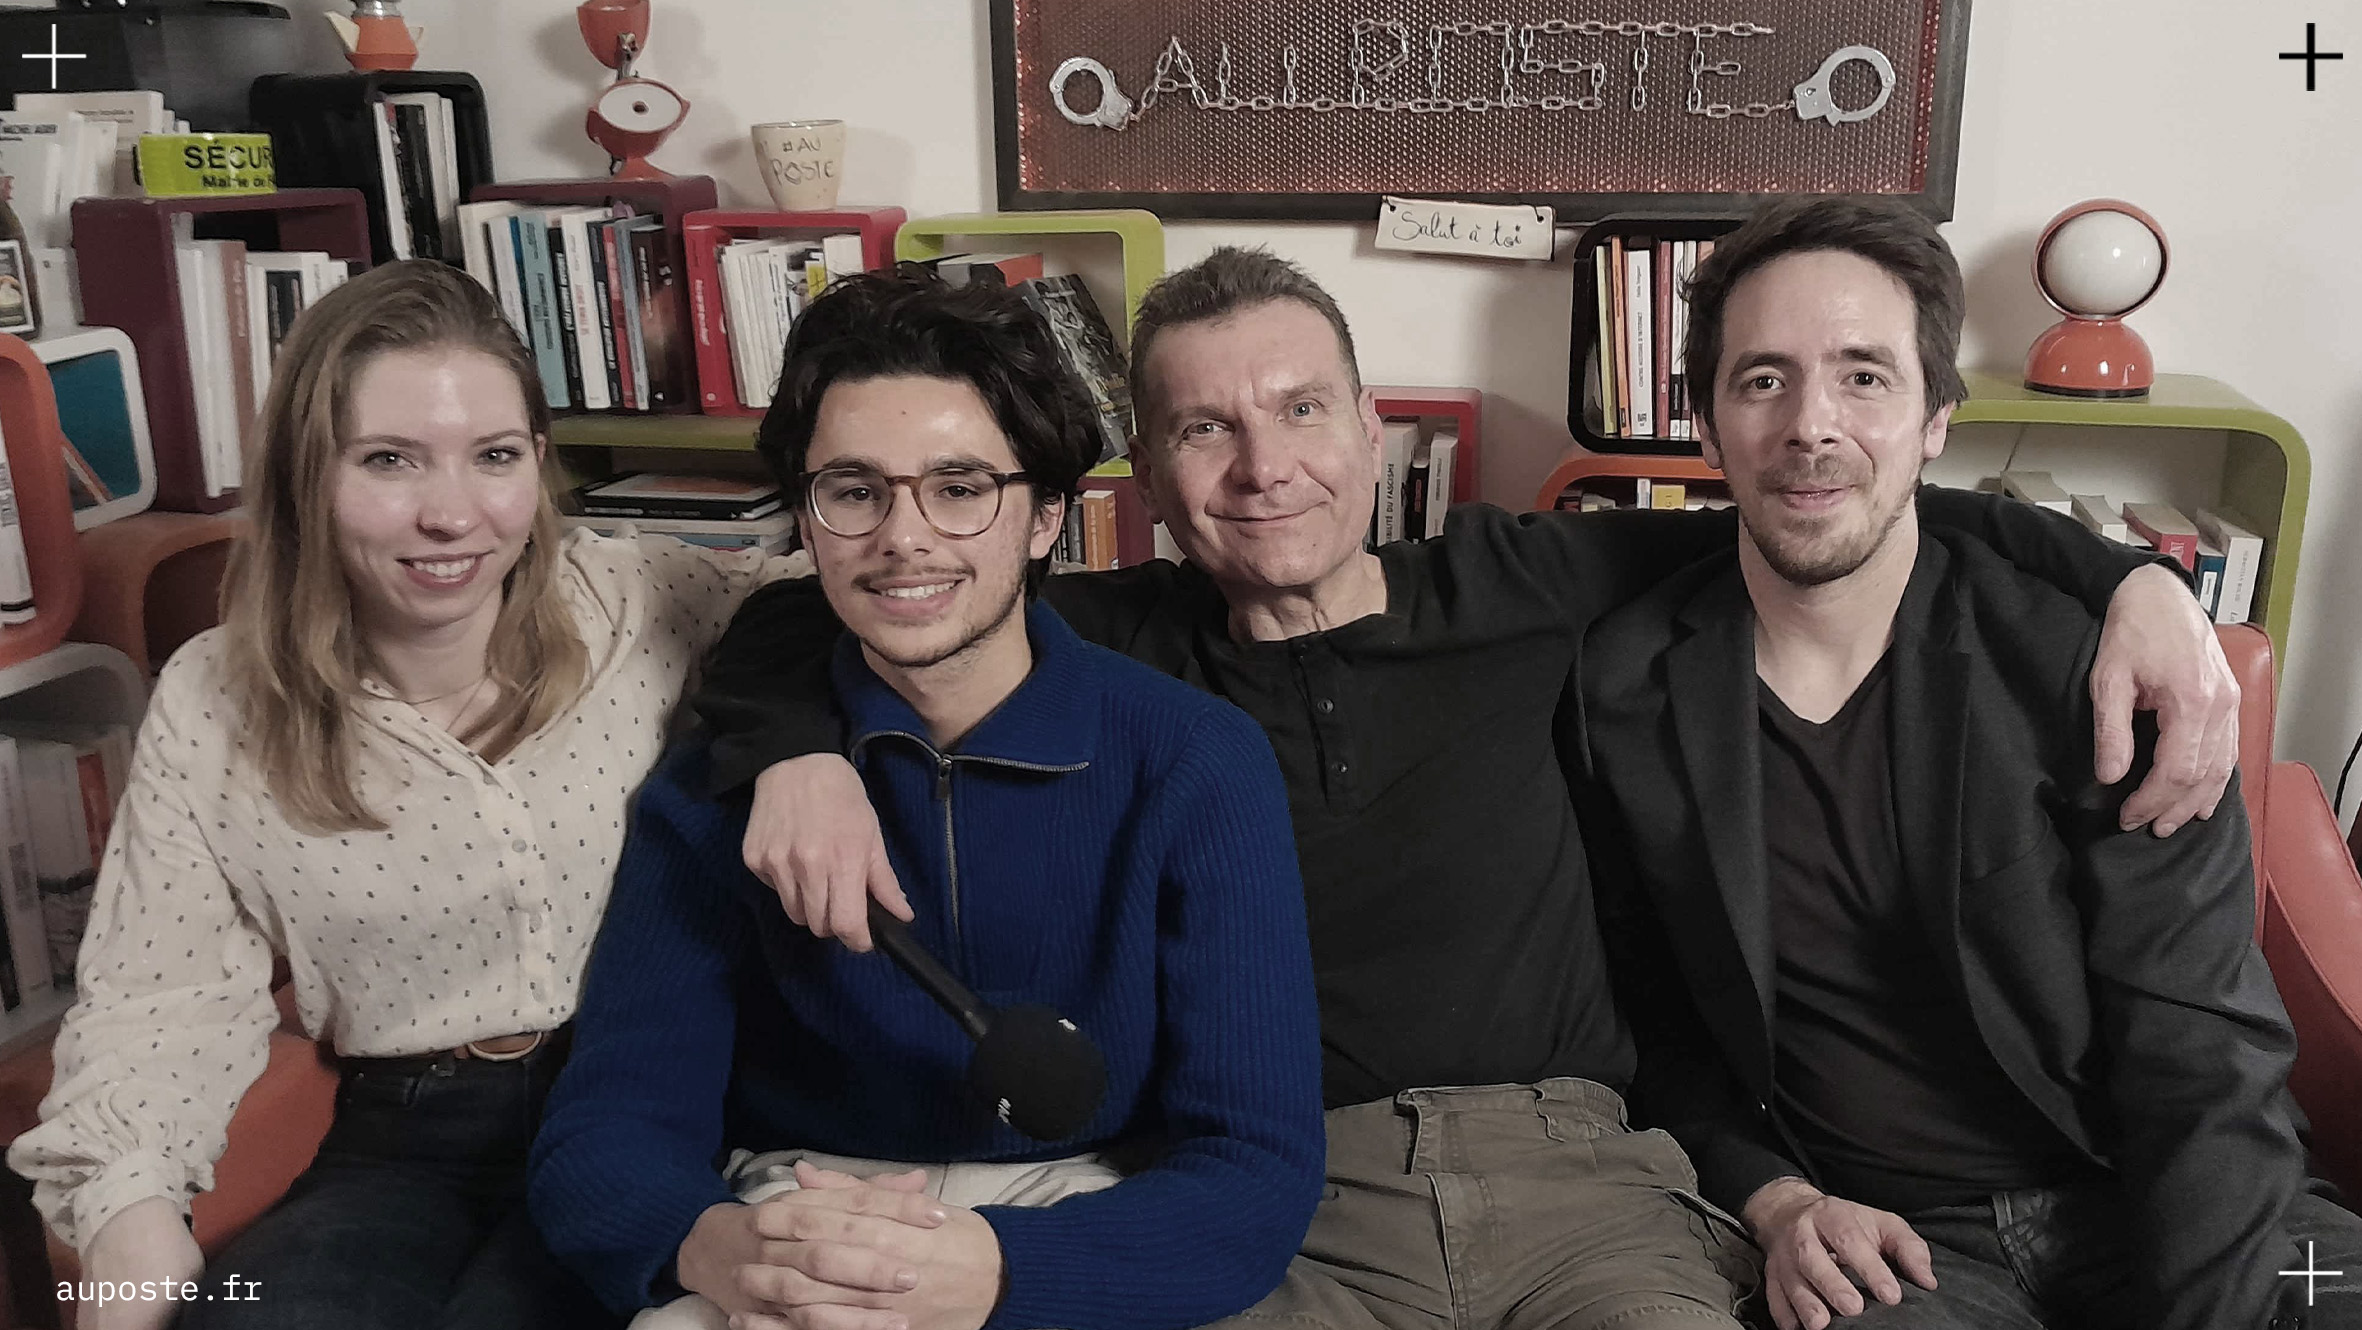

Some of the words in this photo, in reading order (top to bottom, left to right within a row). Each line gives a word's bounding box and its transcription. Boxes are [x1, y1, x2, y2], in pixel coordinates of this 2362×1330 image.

[1392, 211, 1460, 241] Salut
[1469, 225, 1480, 243] à
[1490, 220, 1522, 247] toi
